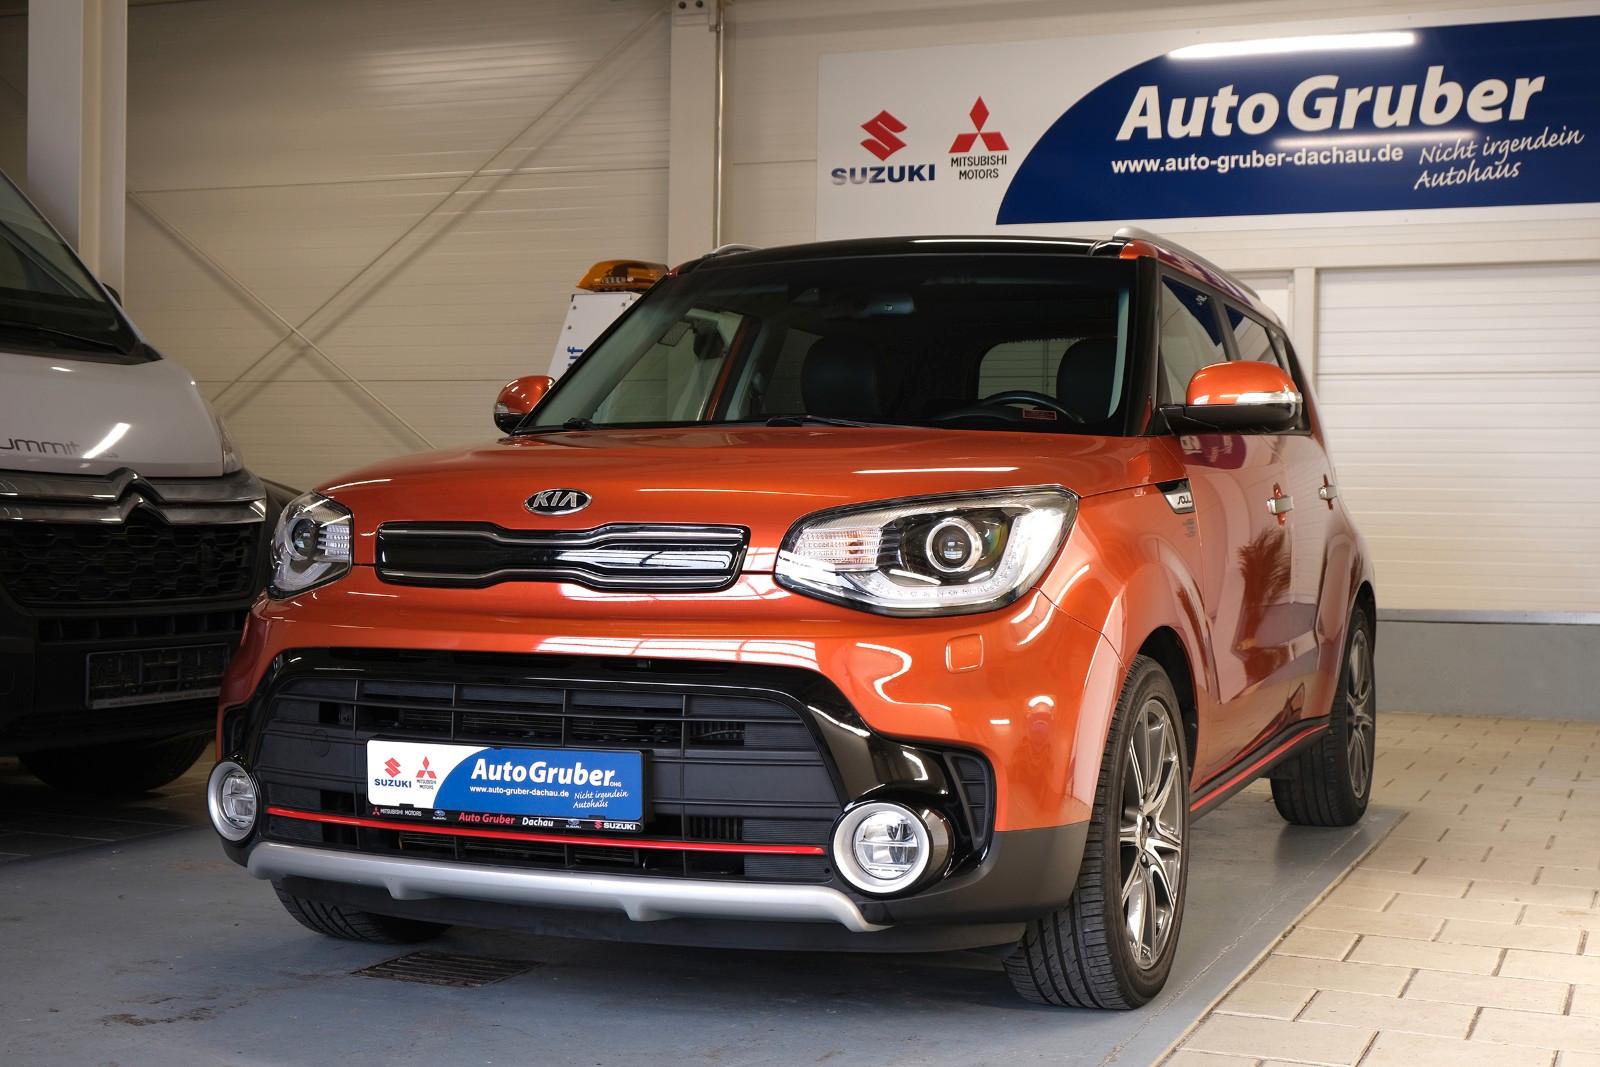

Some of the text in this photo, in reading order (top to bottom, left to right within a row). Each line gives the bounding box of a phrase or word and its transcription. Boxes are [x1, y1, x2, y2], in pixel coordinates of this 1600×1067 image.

[1418, 126, 1585, 168] Nicht irgendein
[950, 154, 1008, 168] MITSUBISHI
[1111, 145, 1404, 175] www.auto-gruber-dachau.de
[831, 163, 936, 186] SUZUKI
[958, 168, 999, 180] MOTORS
[1413, 161, 1522, 191] Autohaus
[532, 491, 578, 508] KIA
[374, 778, 412, 789] SUZUKI
[469, 786, 570, 797] www.auto-gruber-dachau.de
[574, 789, 629, 800] Nicht irgendein
[404, 809, 422, 817] MOTORS
[458, 811, 554, 827] Auto Gruber Dachau
[603, 822, 636, 830] SUZUKI
